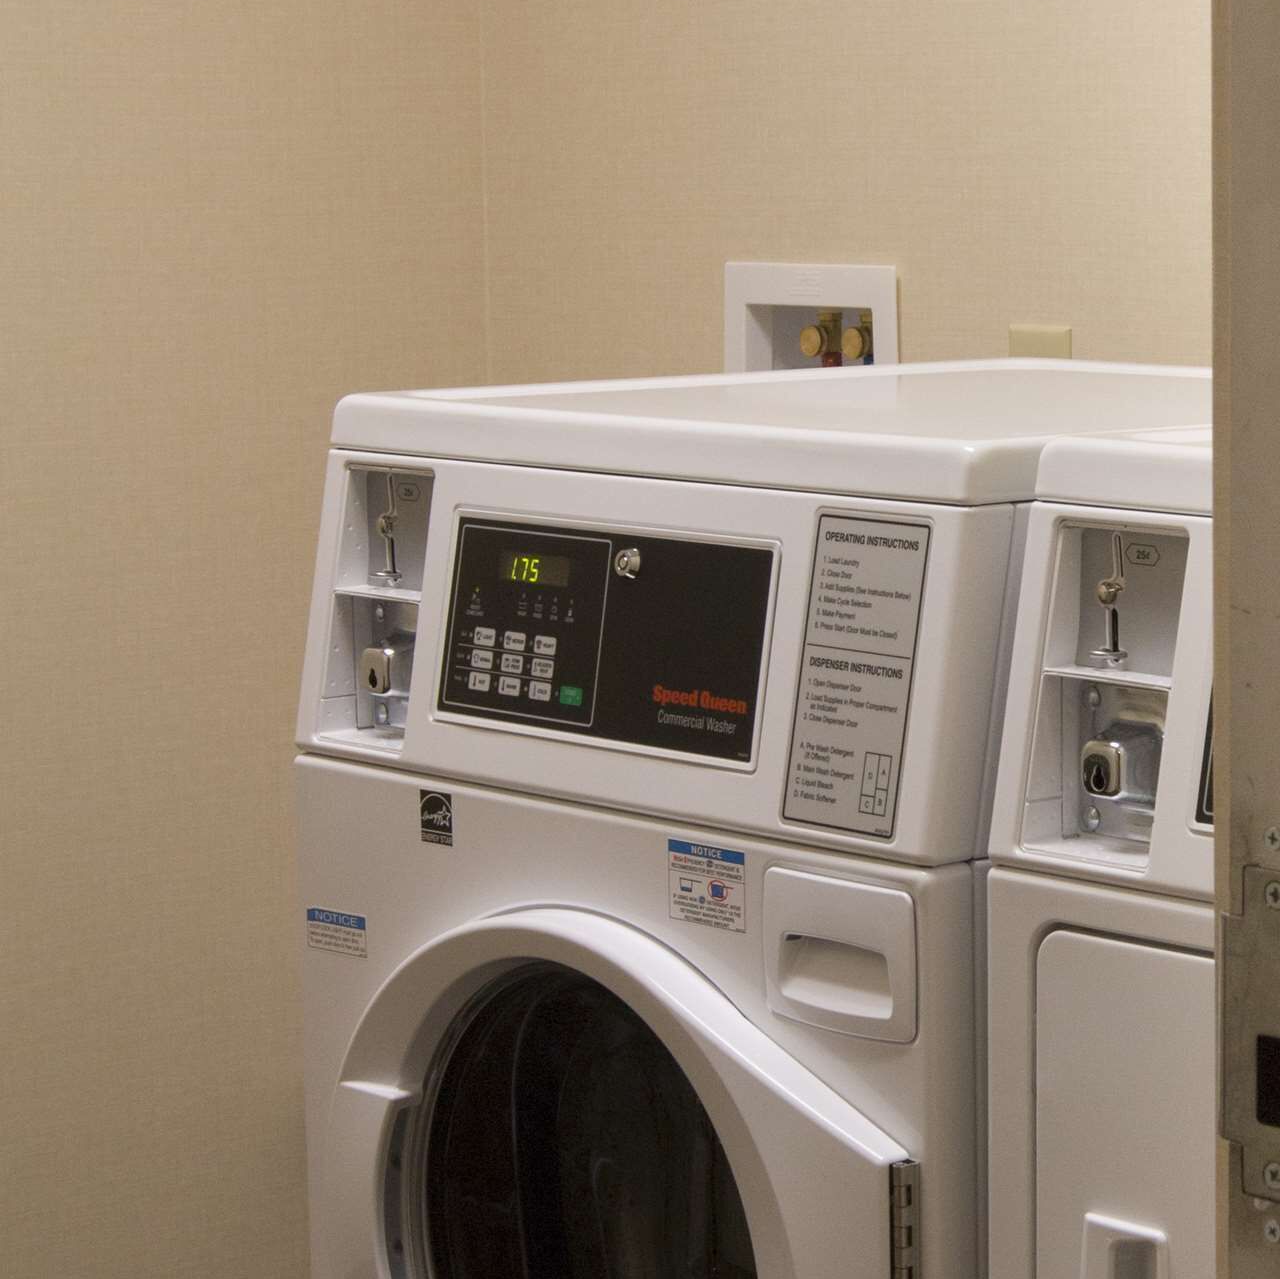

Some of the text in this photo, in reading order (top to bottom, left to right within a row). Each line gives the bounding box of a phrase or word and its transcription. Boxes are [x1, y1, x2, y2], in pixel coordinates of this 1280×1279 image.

[825, 531, 919, 551] OPERATING INSTRUCTIONS
[512, 557, 540, 582] 1.75
[841, 558, 860, 568] Laundry
[809, 656, 904, 680] DISPENSER INSTRUCTIONS
[653, 684, 747, 714] Speed Queen
[657, 709, 737, 735] Commercial Washer
[864, 800, 871, 809] C
[691, 845, 723, 859] NOTICE
[315, 910, 359, 928] NOTICE
